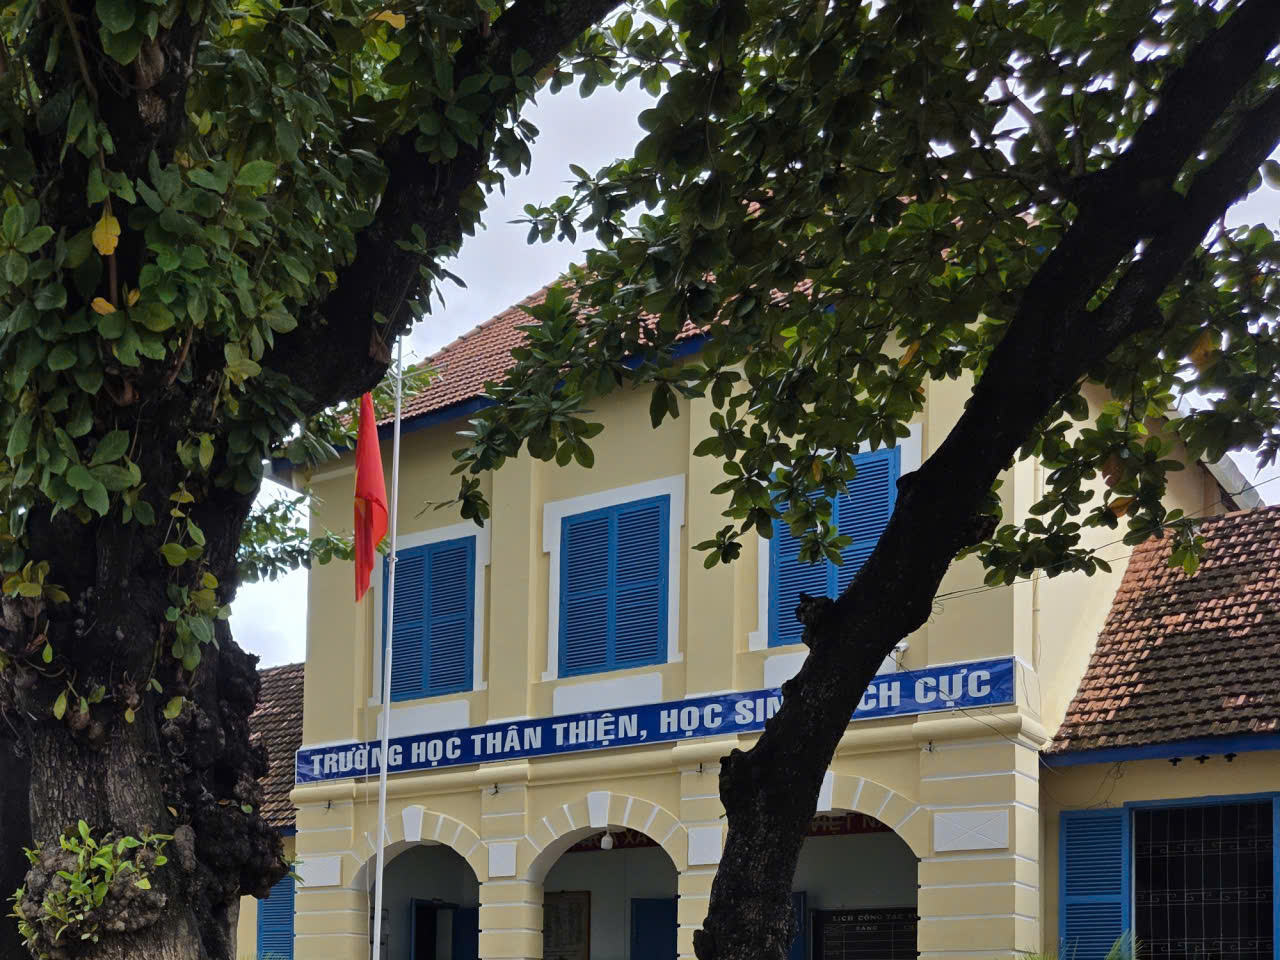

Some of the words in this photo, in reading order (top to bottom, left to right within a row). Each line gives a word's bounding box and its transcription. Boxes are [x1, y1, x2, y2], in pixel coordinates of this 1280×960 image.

[310, 744, 403, 776] TRƯỜNG
[411, 737, 461, 767] HỌC
[470, 725, 543, 756] THÂN
[552, 712, 648, 746] THIỆN,
[659, 703, 722, 736] HỌC
[735, 695, 785, 725] SIN
[914, 668, 991, 707] CỰC
